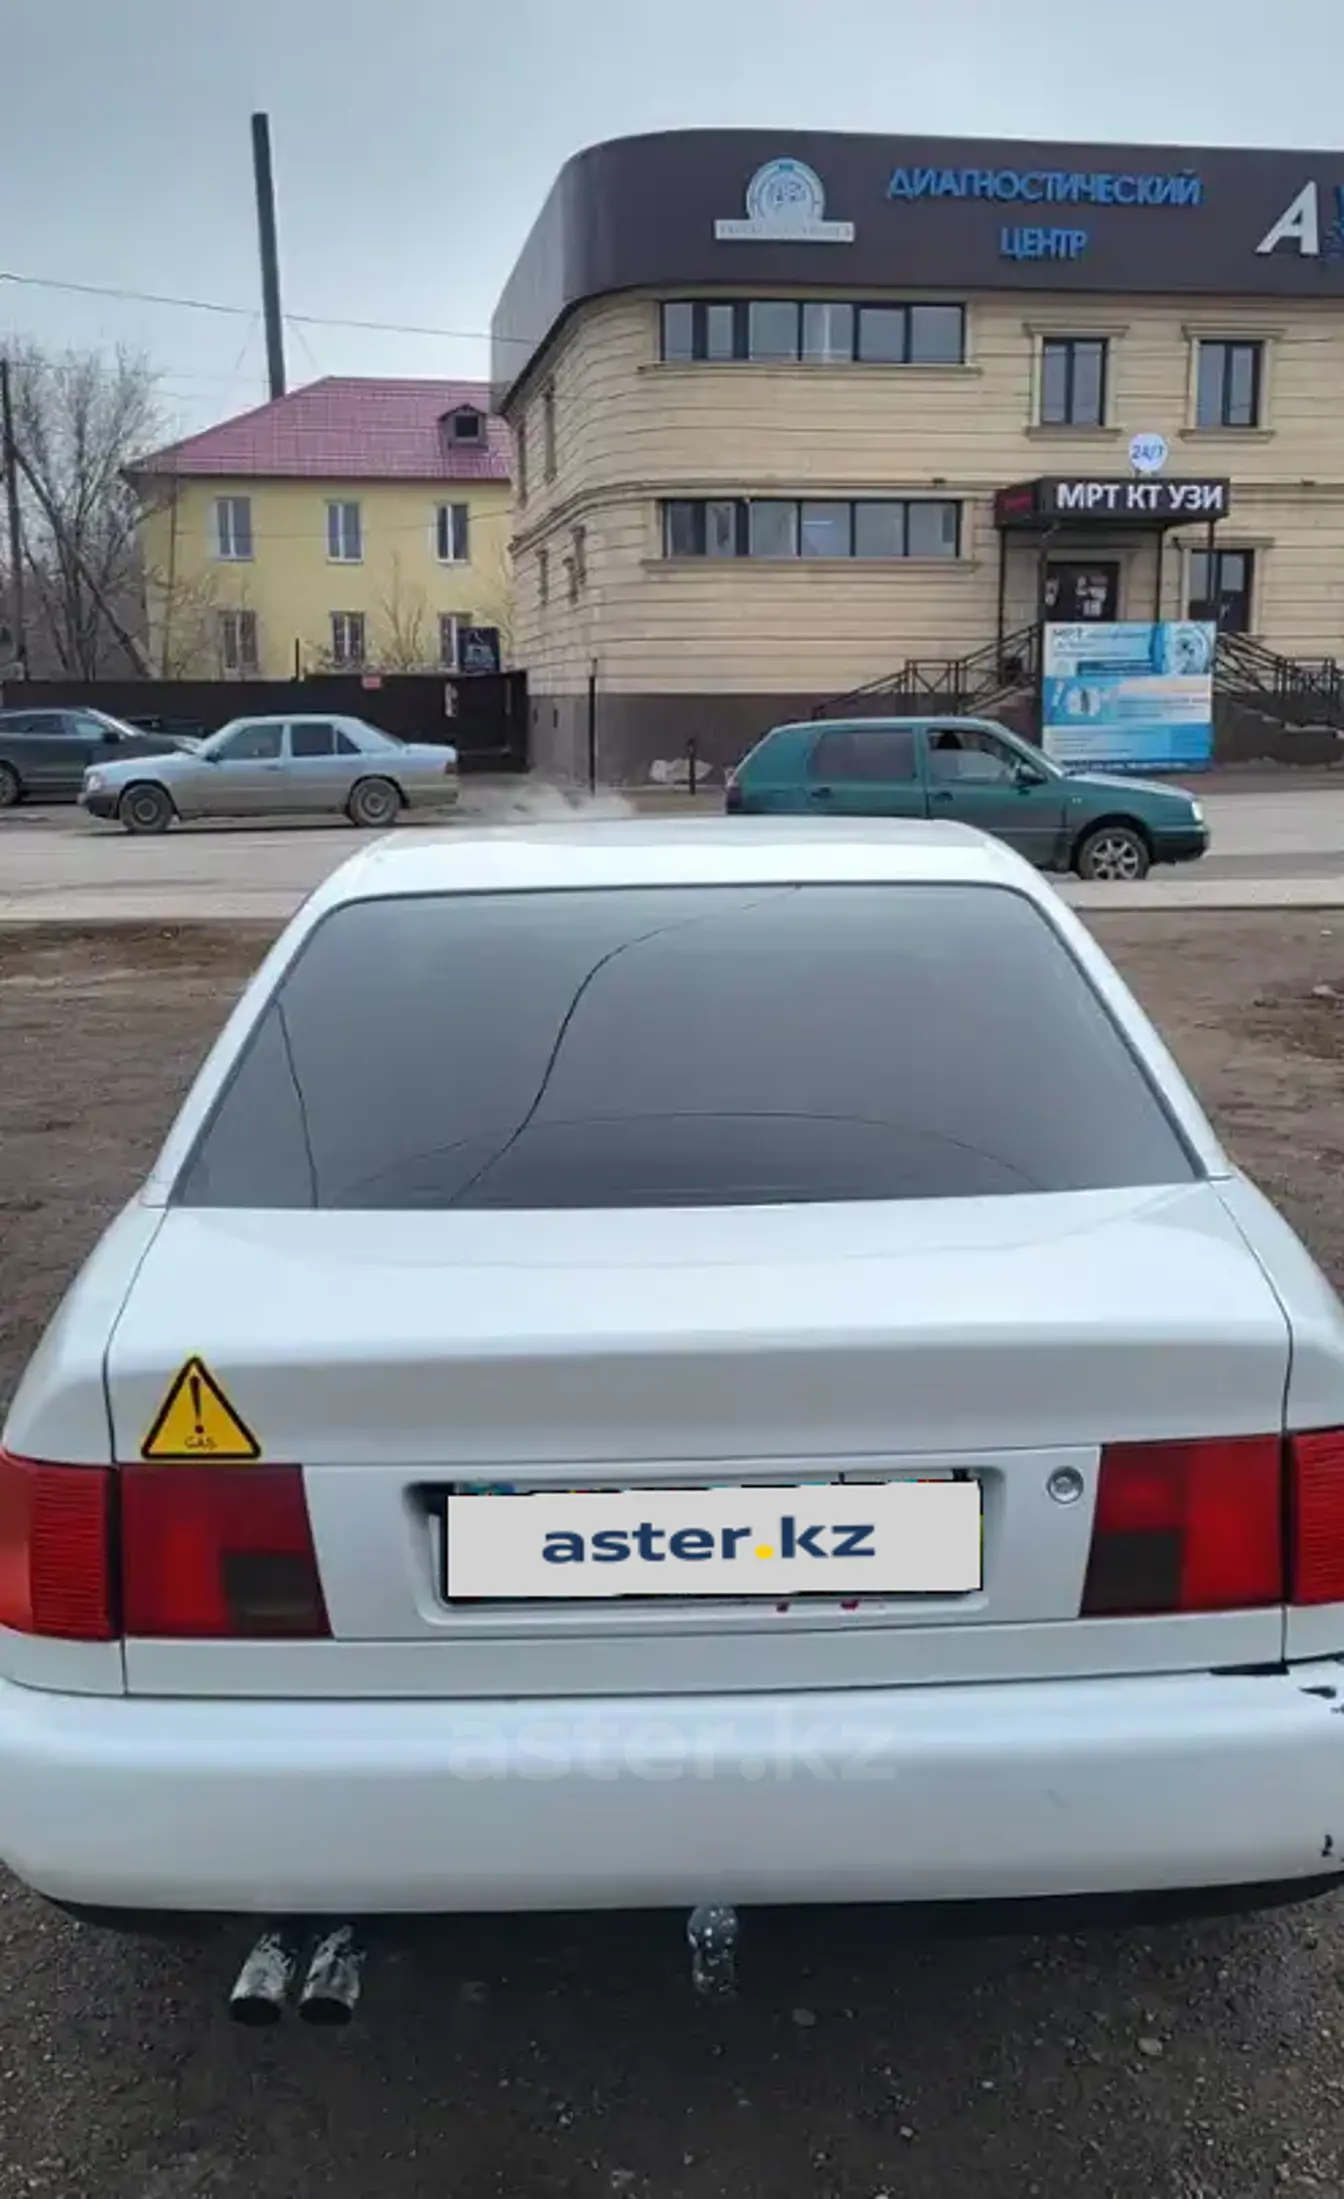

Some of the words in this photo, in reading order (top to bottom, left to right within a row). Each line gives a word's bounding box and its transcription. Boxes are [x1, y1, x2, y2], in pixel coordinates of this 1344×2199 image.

[887, 168, 1203, 204] ДИАГНОСТИЧЕСКИЙ
[999, 227, 1087, 259] ЦЕНТР
[1057, 483, 1119, 508] МРТ
[1127, 484, 1162, 508] КТ
[1168, 485, 1223, 510] УЗИ
[184, 1436, 217, 1449] GAS
